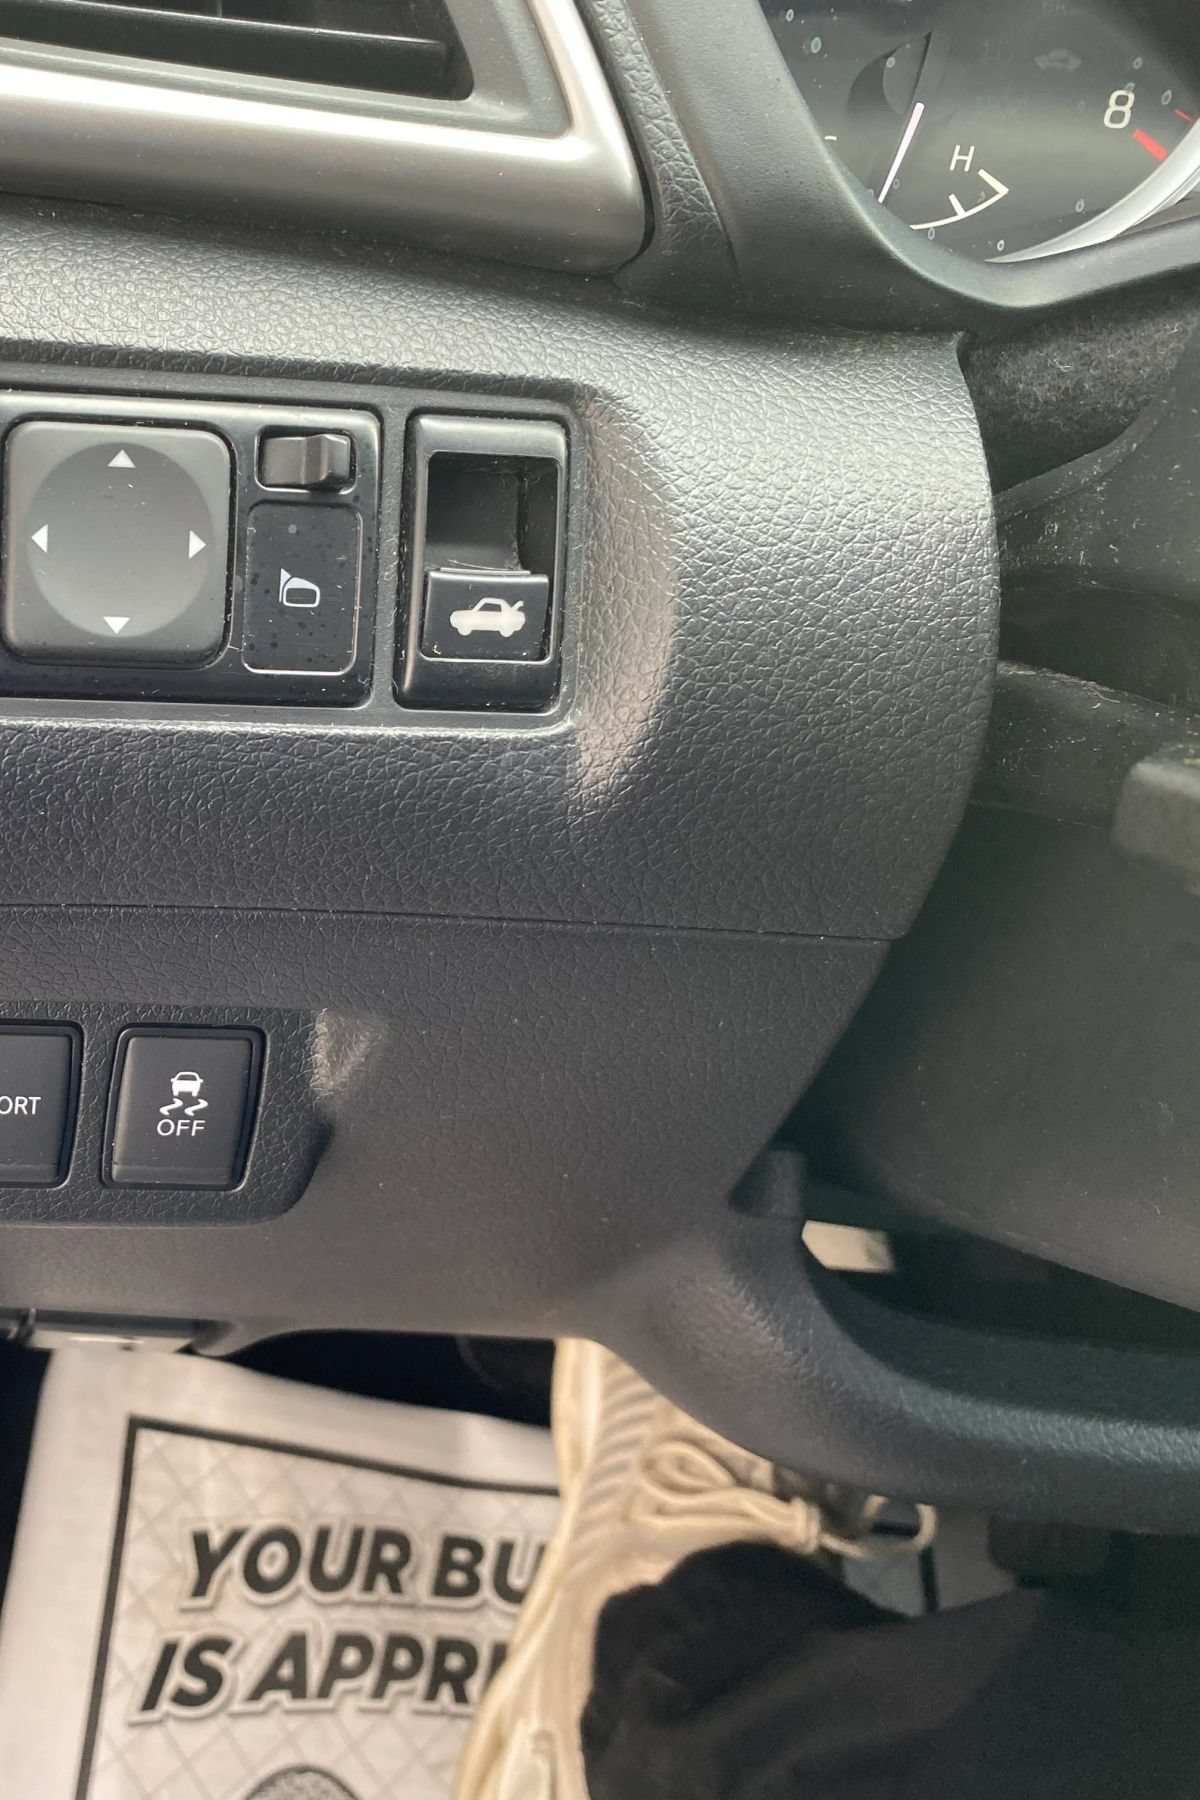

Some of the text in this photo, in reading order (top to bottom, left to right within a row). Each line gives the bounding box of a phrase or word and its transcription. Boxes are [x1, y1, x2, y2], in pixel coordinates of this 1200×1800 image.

[1103, 89, 1135, 129] 8
[949, 144, 975, 172] H
[156, 1118, 206, 1137] OFF
[191, 1526, 412, 1599] YOUR
[140, 1637, 233, 1712] IS
